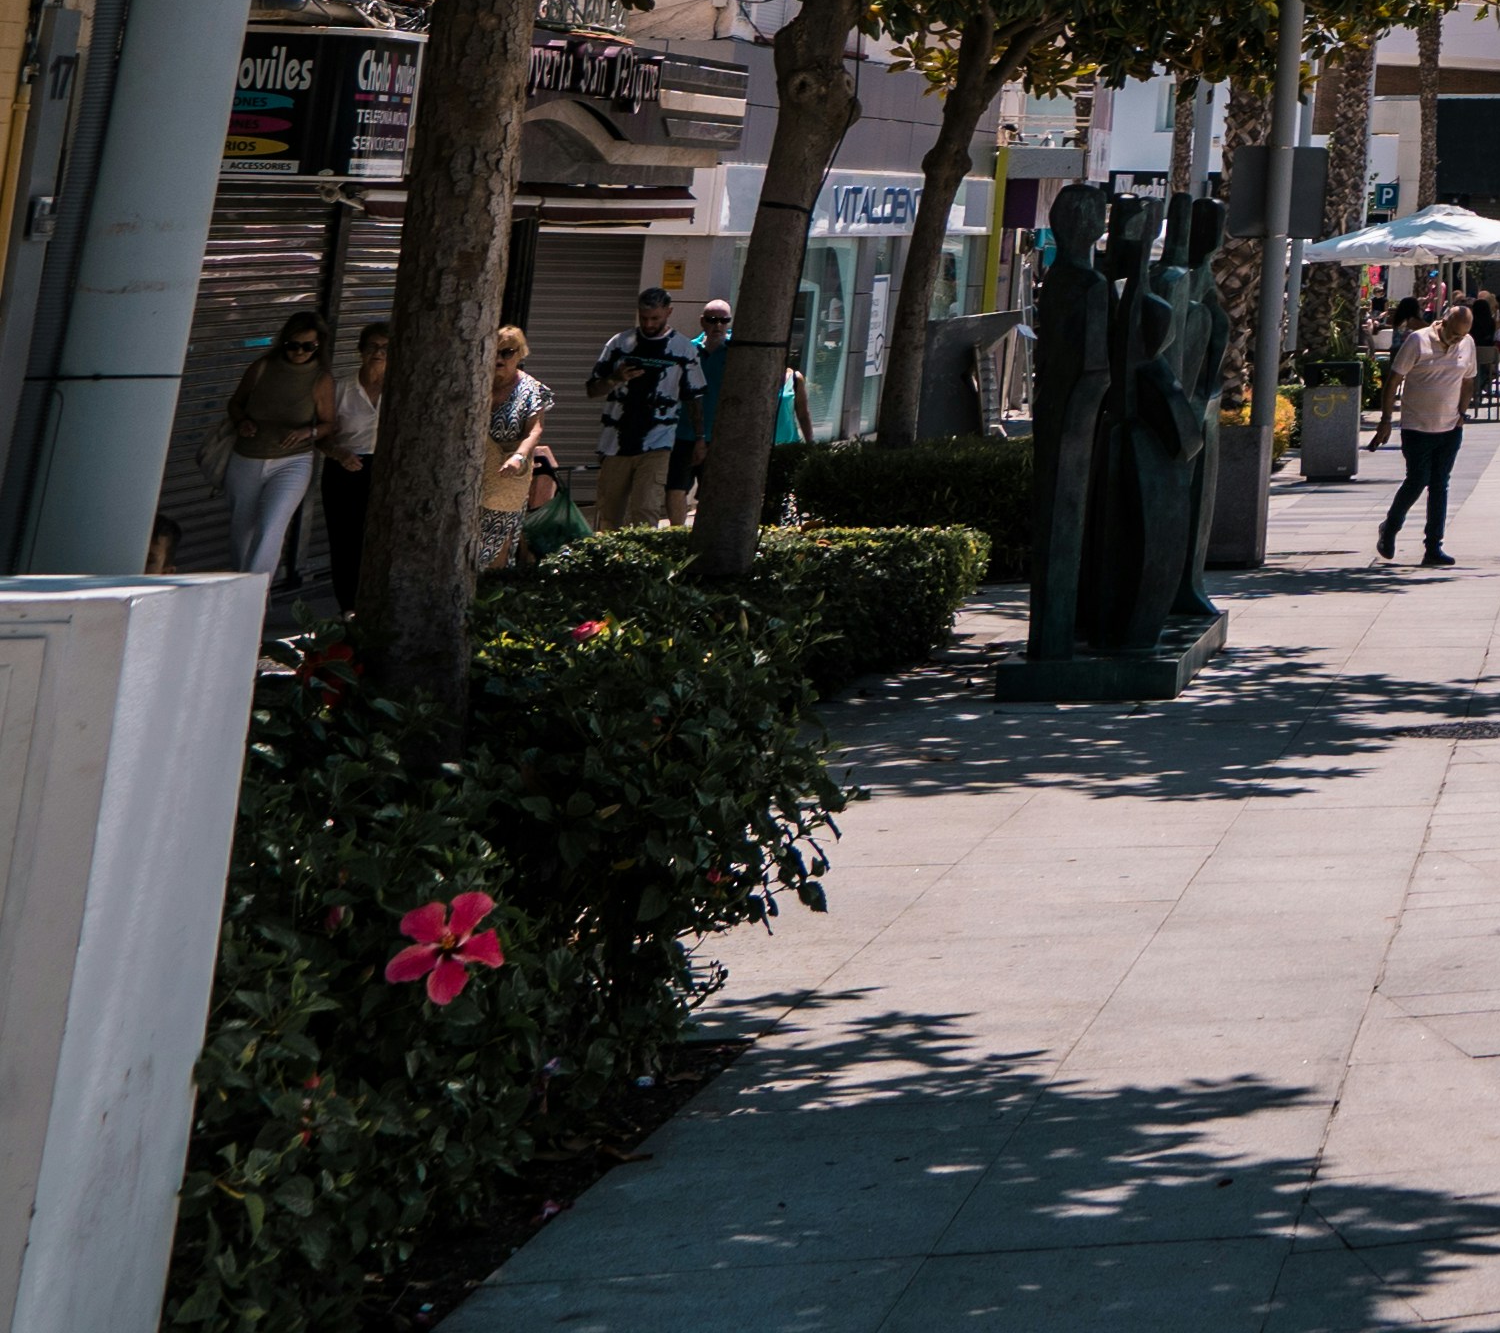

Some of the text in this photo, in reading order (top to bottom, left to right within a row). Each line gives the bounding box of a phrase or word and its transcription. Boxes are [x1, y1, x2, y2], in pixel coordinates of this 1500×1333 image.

[238, 46, 314, 90] oviles
[230, 162, 292, 171] ACCESSORIES
[833, 186, 924, 224] VITALDEN
[1381, 186, 1394, 204] P
